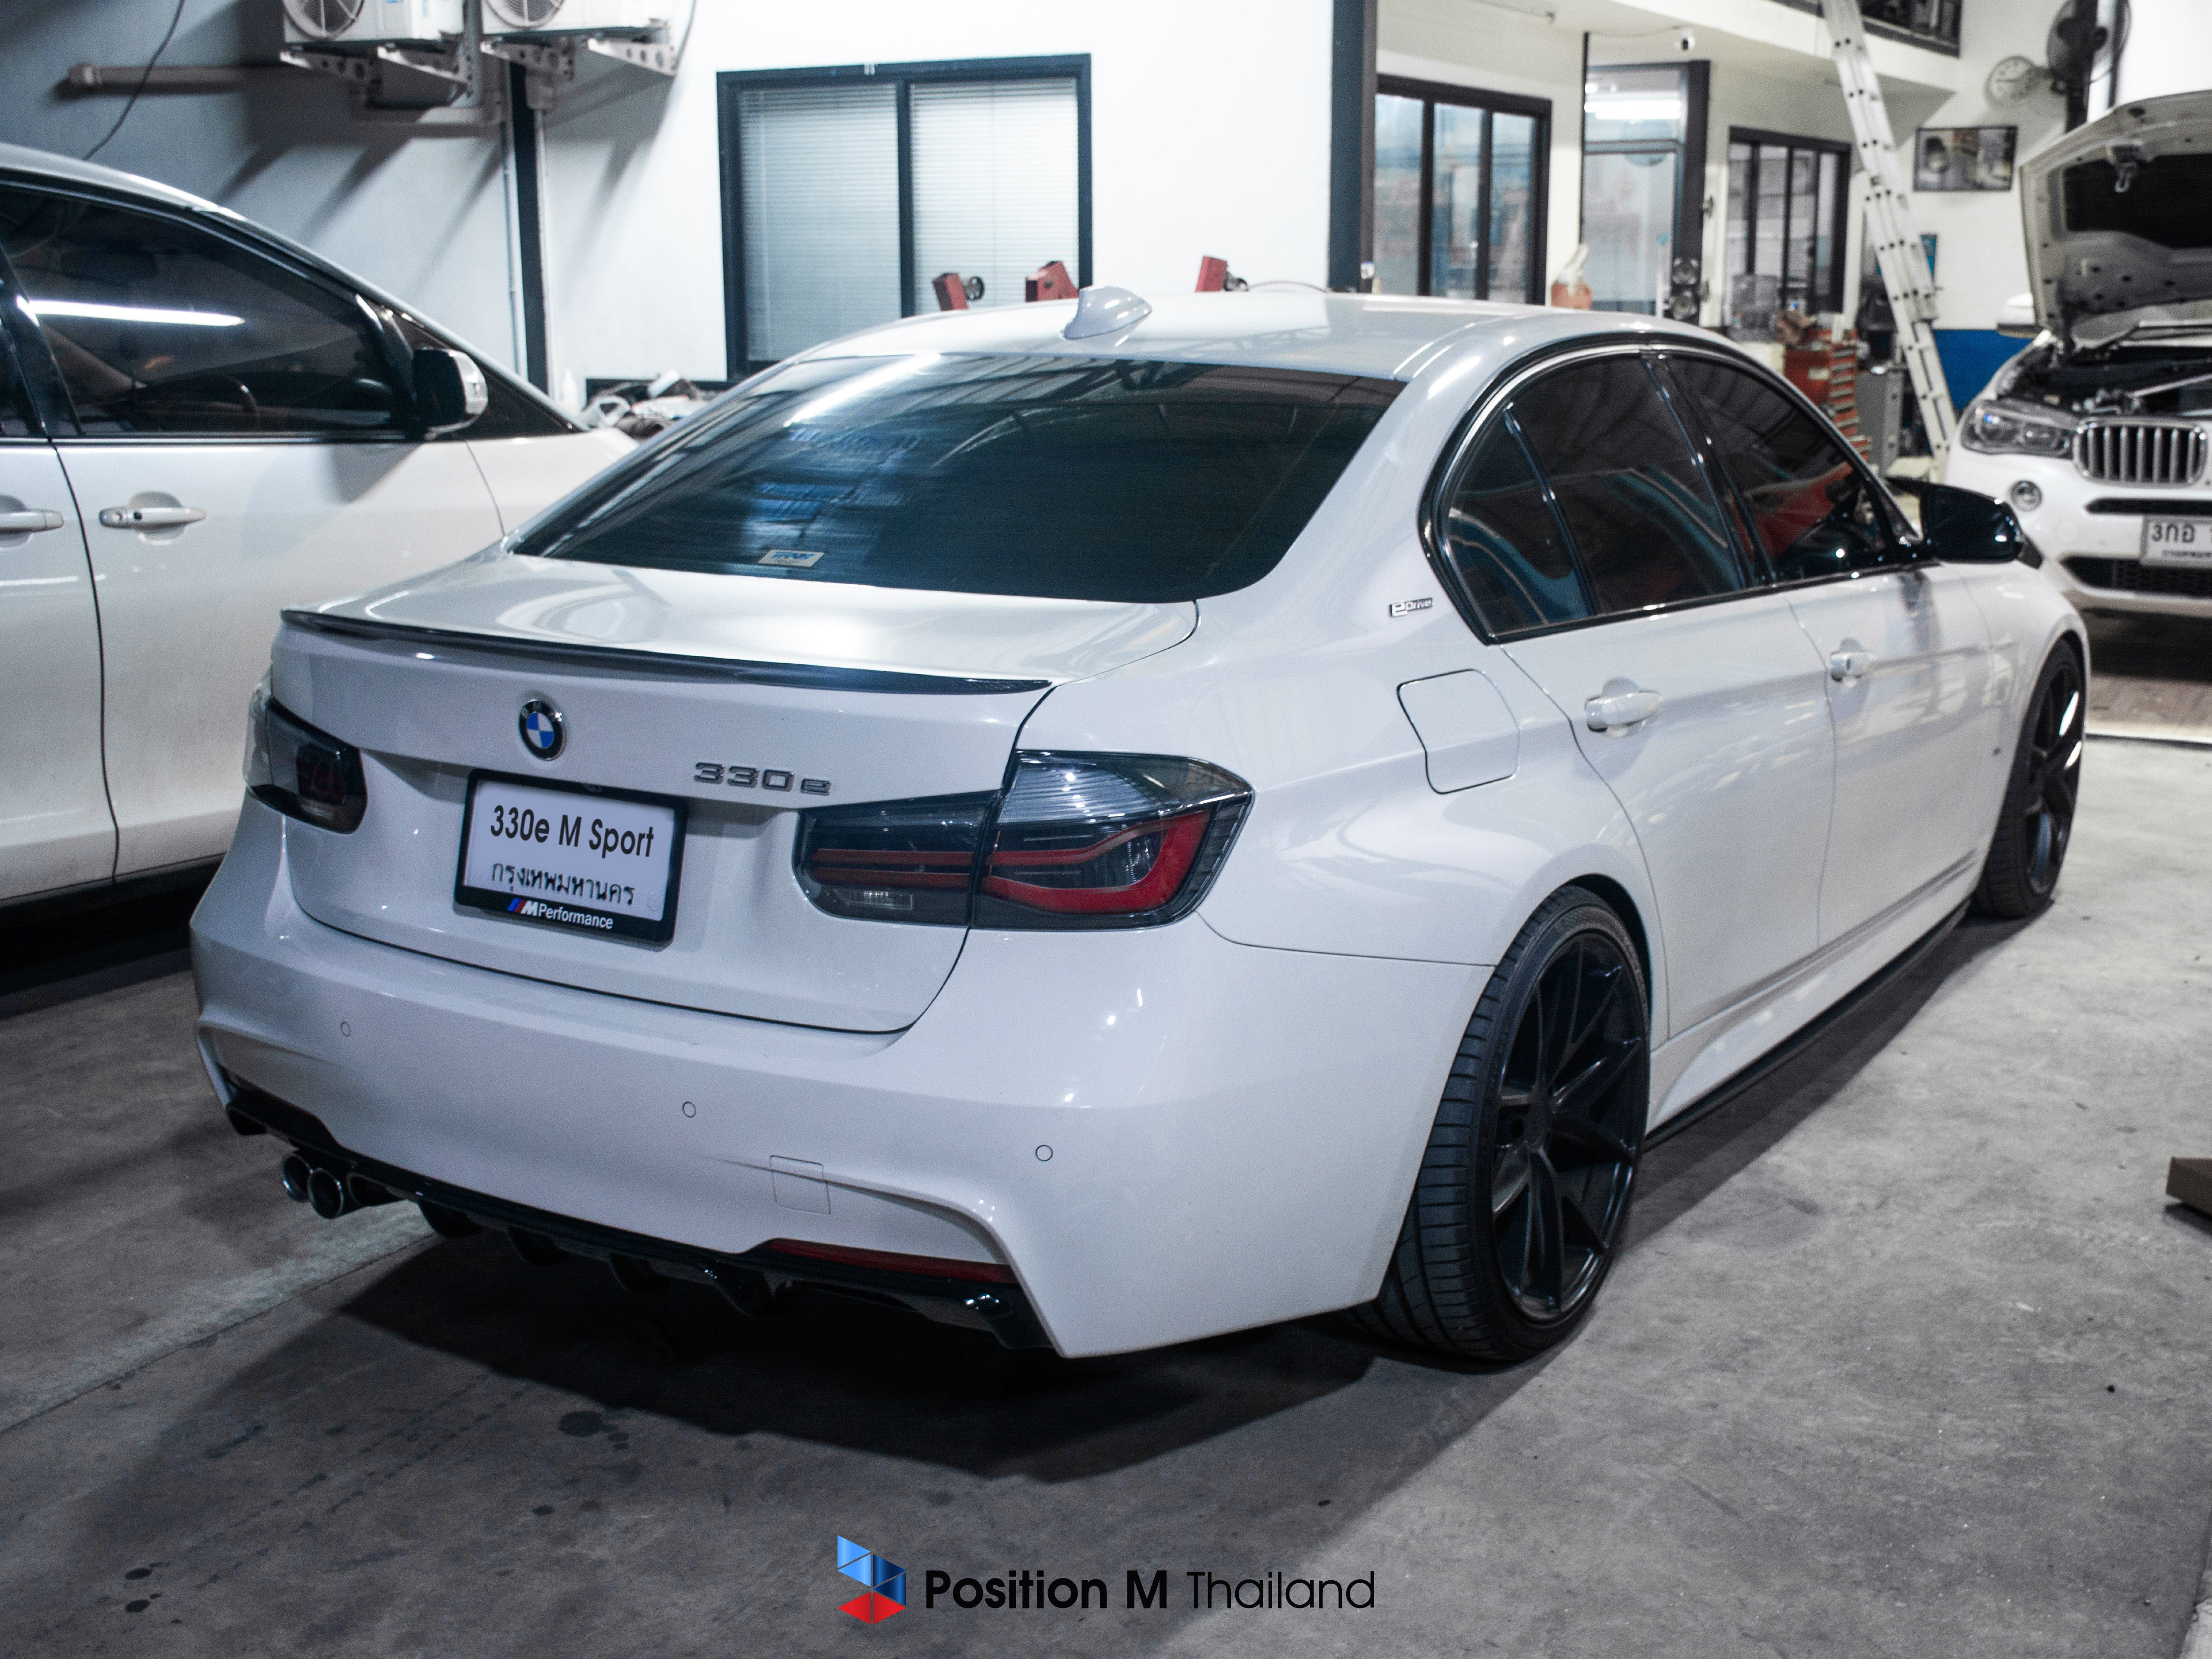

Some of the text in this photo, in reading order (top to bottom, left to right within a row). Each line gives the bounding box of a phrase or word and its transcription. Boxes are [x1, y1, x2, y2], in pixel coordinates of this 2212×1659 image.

[1390, 597, 1433, 617] eDrive
[491, 805, 654, 859] 330e M Sport
[492, 863, 635, 905] กรุงเทพมหานคร
